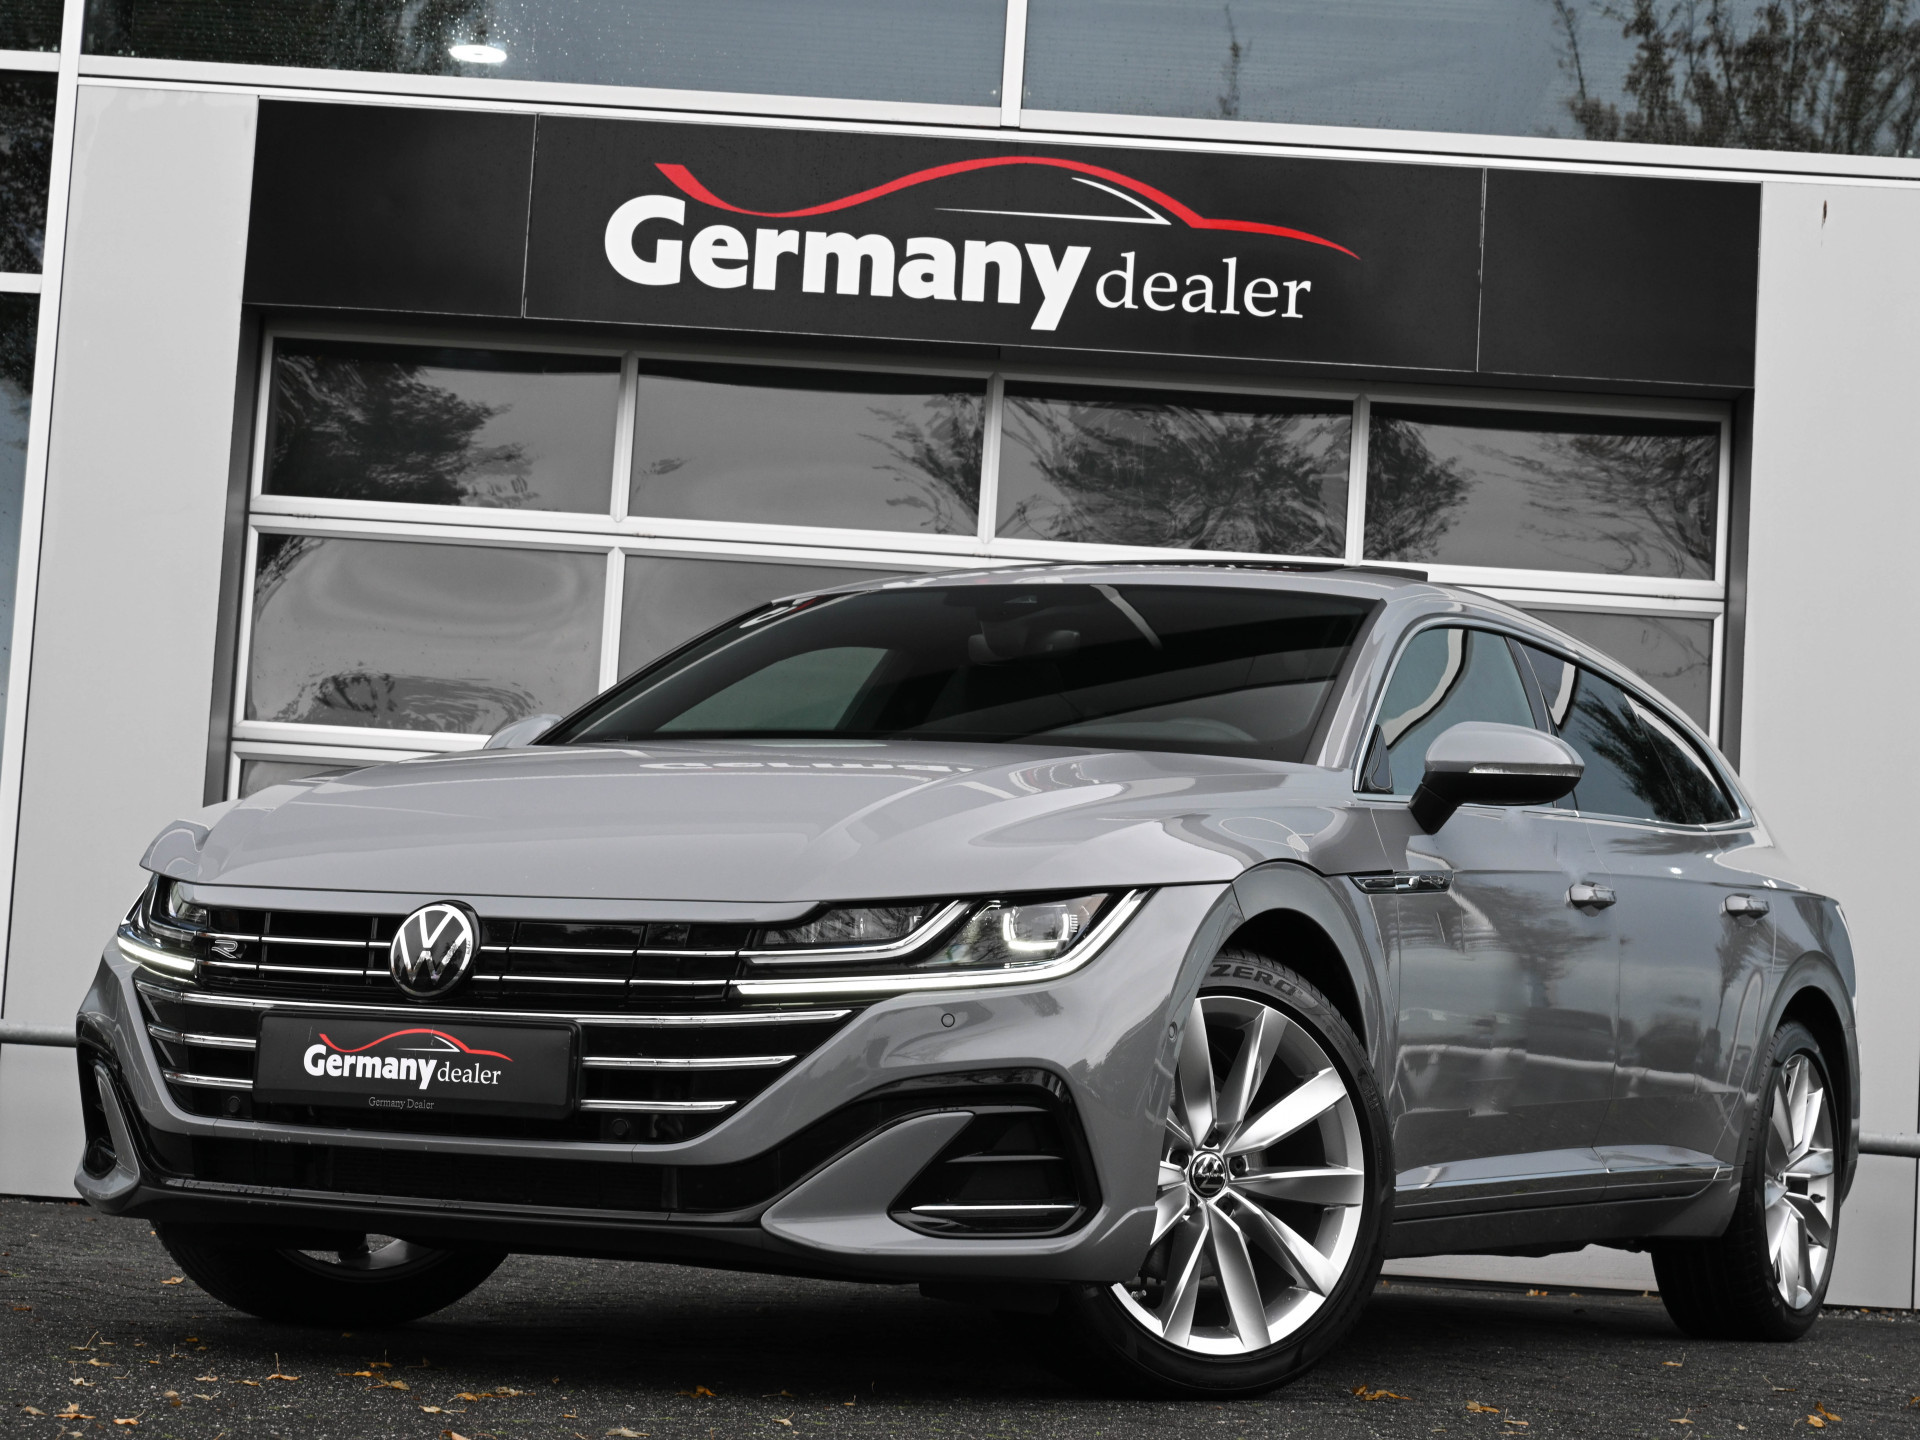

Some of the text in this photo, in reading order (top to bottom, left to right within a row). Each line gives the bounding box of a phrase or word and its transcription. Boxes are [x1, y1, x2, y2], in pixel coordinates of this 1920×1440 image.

[604, 194, 1312, 331] Germany dealer
[211, 940, 238, 959] R
[1210, 964, 1299, 996] ZERO
[303, 1043, 502, 1090] Germany dealer
[368, 1096, 434, 1110] Germany Dealer
